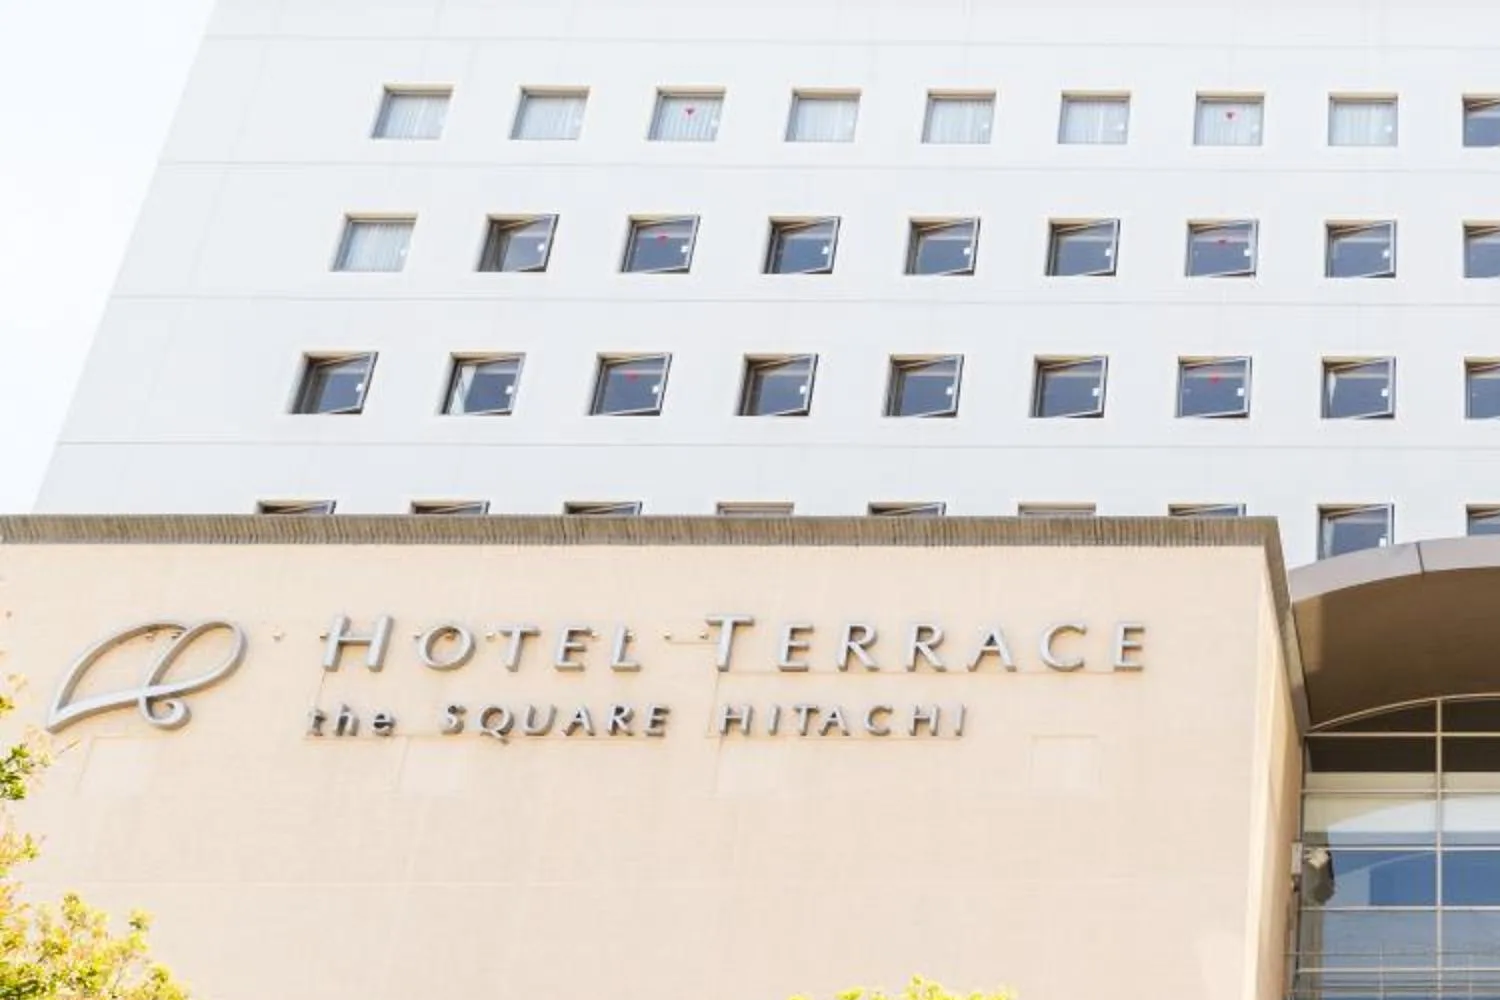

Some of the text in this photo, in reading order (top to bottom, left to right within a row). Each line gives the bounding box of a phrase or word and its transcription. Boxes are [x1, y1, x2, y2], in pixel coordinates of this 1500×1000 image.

[321, 614, 1147, 672] HOTEL TERRACE
[306, 703, 968, 745] the SQUARE HITACHI
